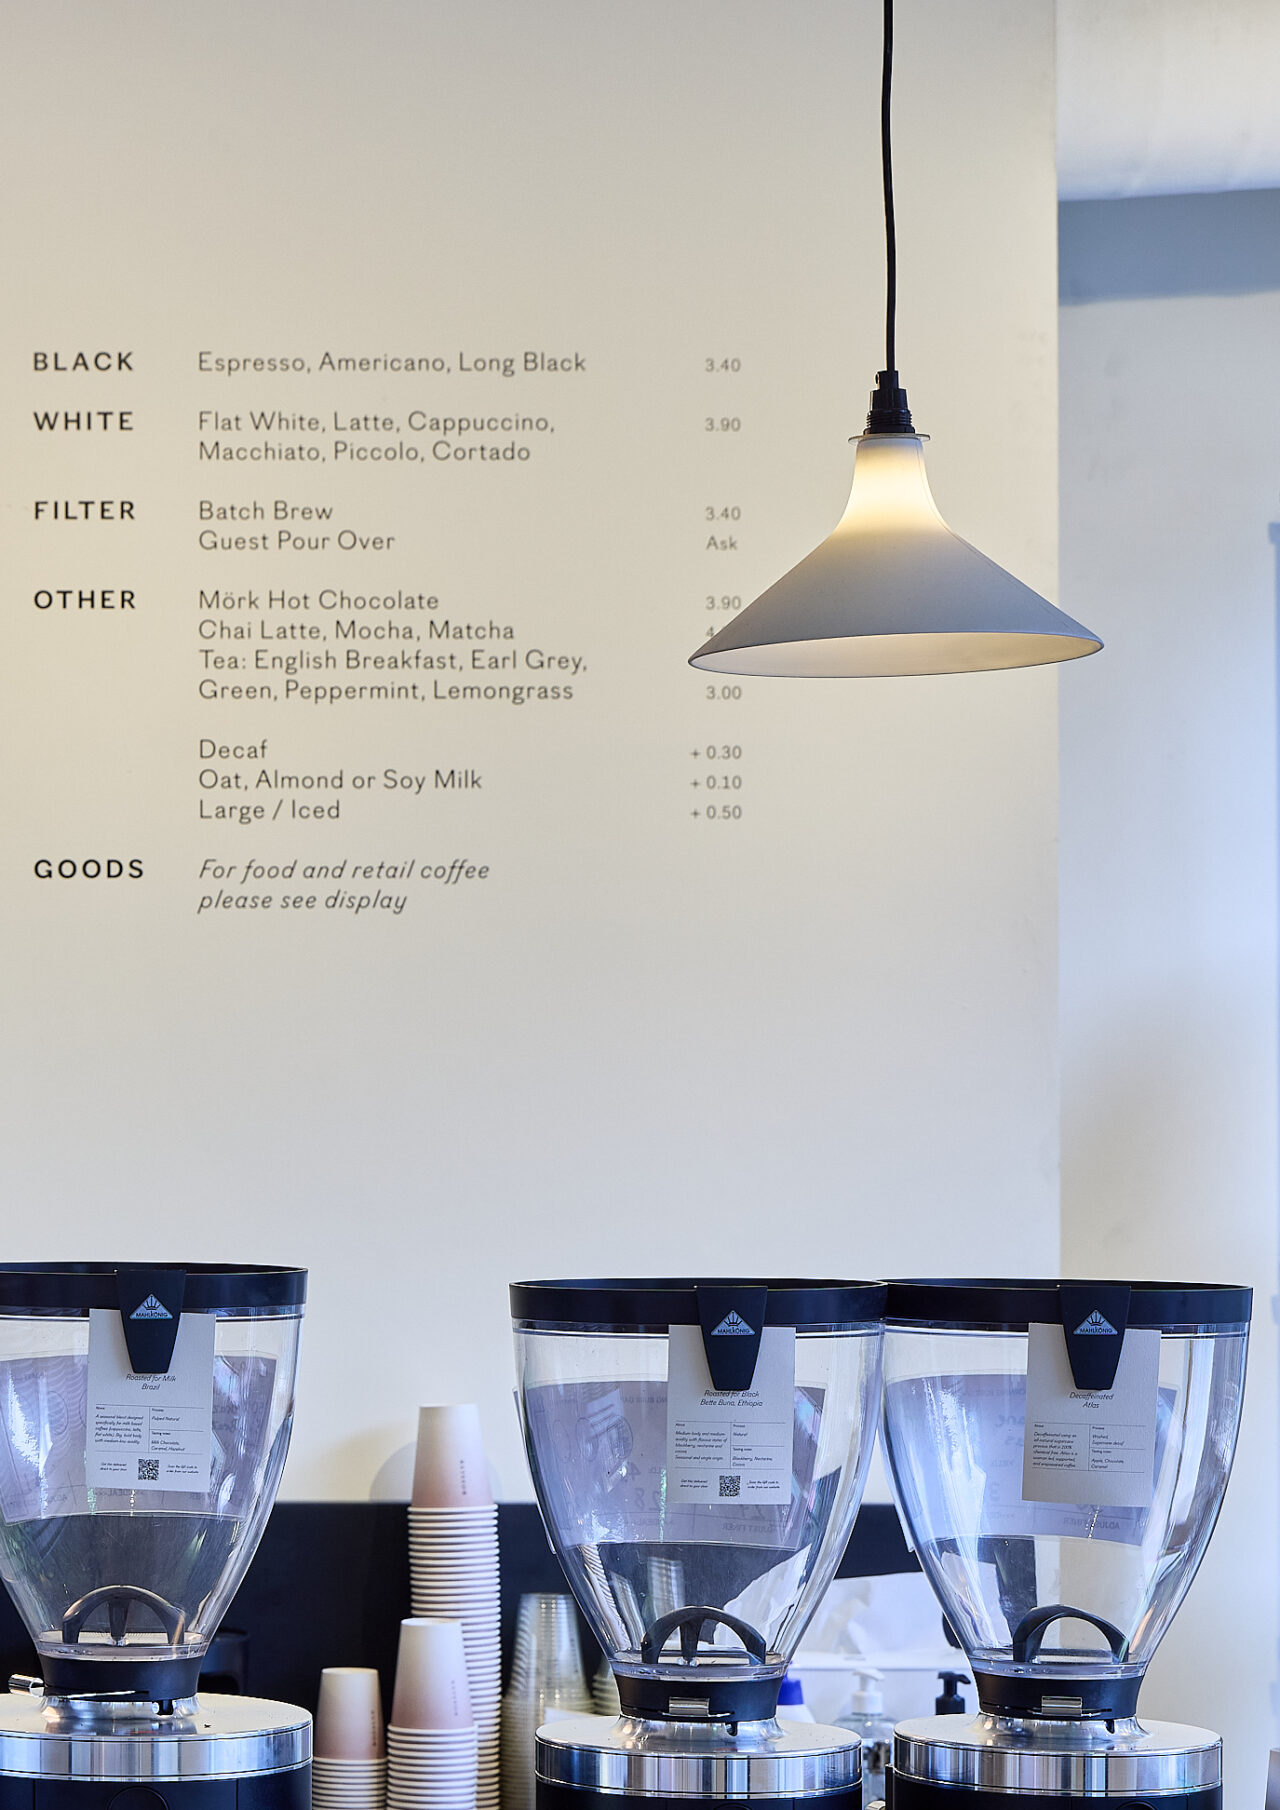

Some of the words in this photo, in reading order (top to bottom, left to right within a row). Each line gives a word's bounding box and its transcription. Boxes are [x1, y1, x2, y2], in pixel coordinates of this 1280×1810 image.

[33, 351, 133, 372] BLACK
[199, 351, 311, 377] Espresso,
[318, 351, 451, 374] Americano,
[459, 352, 515, 377] Long
[524, 351, 586, 372] Black
[705, 358, 741, 372] 3.40
[33, 411, 134, 431] WHITE
[199, 411, 241, 431] Flat
[249, 411, 325, 433] White,
[334, 411, 400, 433] Latte,
[408, 410, 554, 436] Cappuccino,
[705, 417, 741, 432] 3.90
[200, 440, 326, 463] Macchiato,
[334, 440, 424, 463] Piccolo,
[432, 440, 530, 461] Cortado
[34, 500, 135, 520] FILTER
[200, 500, 264, 521] Batch
[274, 500, 333, 520] Brew
[705, 506, 741, 521] 3.40
[199, 529, 269, 550] Guest
[278, 530, 330, 550] Pour
[338, 530, 395, 550] Over
[706, 535, 737, 551] Ask
[33, 589, 136, 610] OTHER
[199, 589, 259, 610] Mörk
[269, 589, 310, 610] Hot
[319, 589, 439, 610] Chocolate
[705, 595, 742, 610] 3.90
[199, 619, 251, 640] Chai
[261, 619, 327, 642] Latte,
[336, 619, 420, 642] Mocha,
[429, 619, 514, 640] Matcha
[199, 649, 246, 670] Tea:
[255, 649, 336, 675] English
[346, 649, 463, 672] Breakfast,
[472, 649, 516, 670] Earl
[525, 649, 587, 675] Grey,
[199, 679, 278, 702] Green,
[286, 679, 425, 704] Peppermint,
[434, 679, 573, 705] Lemongrass
[706, 685, 742, 700] 3.00
[200, 739, 267, 759] Decaf
[706, 745, 742, 760] 0.30
[199, 769, 248, 791] Oat,
[255, 769, 343, 789] Almond
[352, 776, 376, 790] or
[383, 769, 426, 795] Soy
[435, 769, 482, 789] Milk
[706, 775, 742, 790] 0.10
[200, 799, 265, 825] Large
[292, 799, 340, 819] Iced
[706, 805, 742, 820] 0.50
[34, 859, 143, 879] GOODS
[199, 859, 235, 879] For
[240, 859, 298, 885] food
[303, 859, 347, 879] and
[352, 859, 415, 879] retail
[420, 859, 490, 885] coffee
[197, 889, 273, 915] please
[280, 895, 317, 909] see
[325, 889, 407, 915] display
[126, 1373, 151, 1382] Roasted
[151, 1374, 160, 1383] for
[162, 1375, 176, 1383] Milk
[704, 1390, 730, 1398] Roasted
[730, 1391, 740, 1399] for
[737, 1399, 763, 1408] Ethiopia
[1069, 1391, 1115, 1400] Decaffeinated
[1082, 1401, 1100, 1409] Atlas
